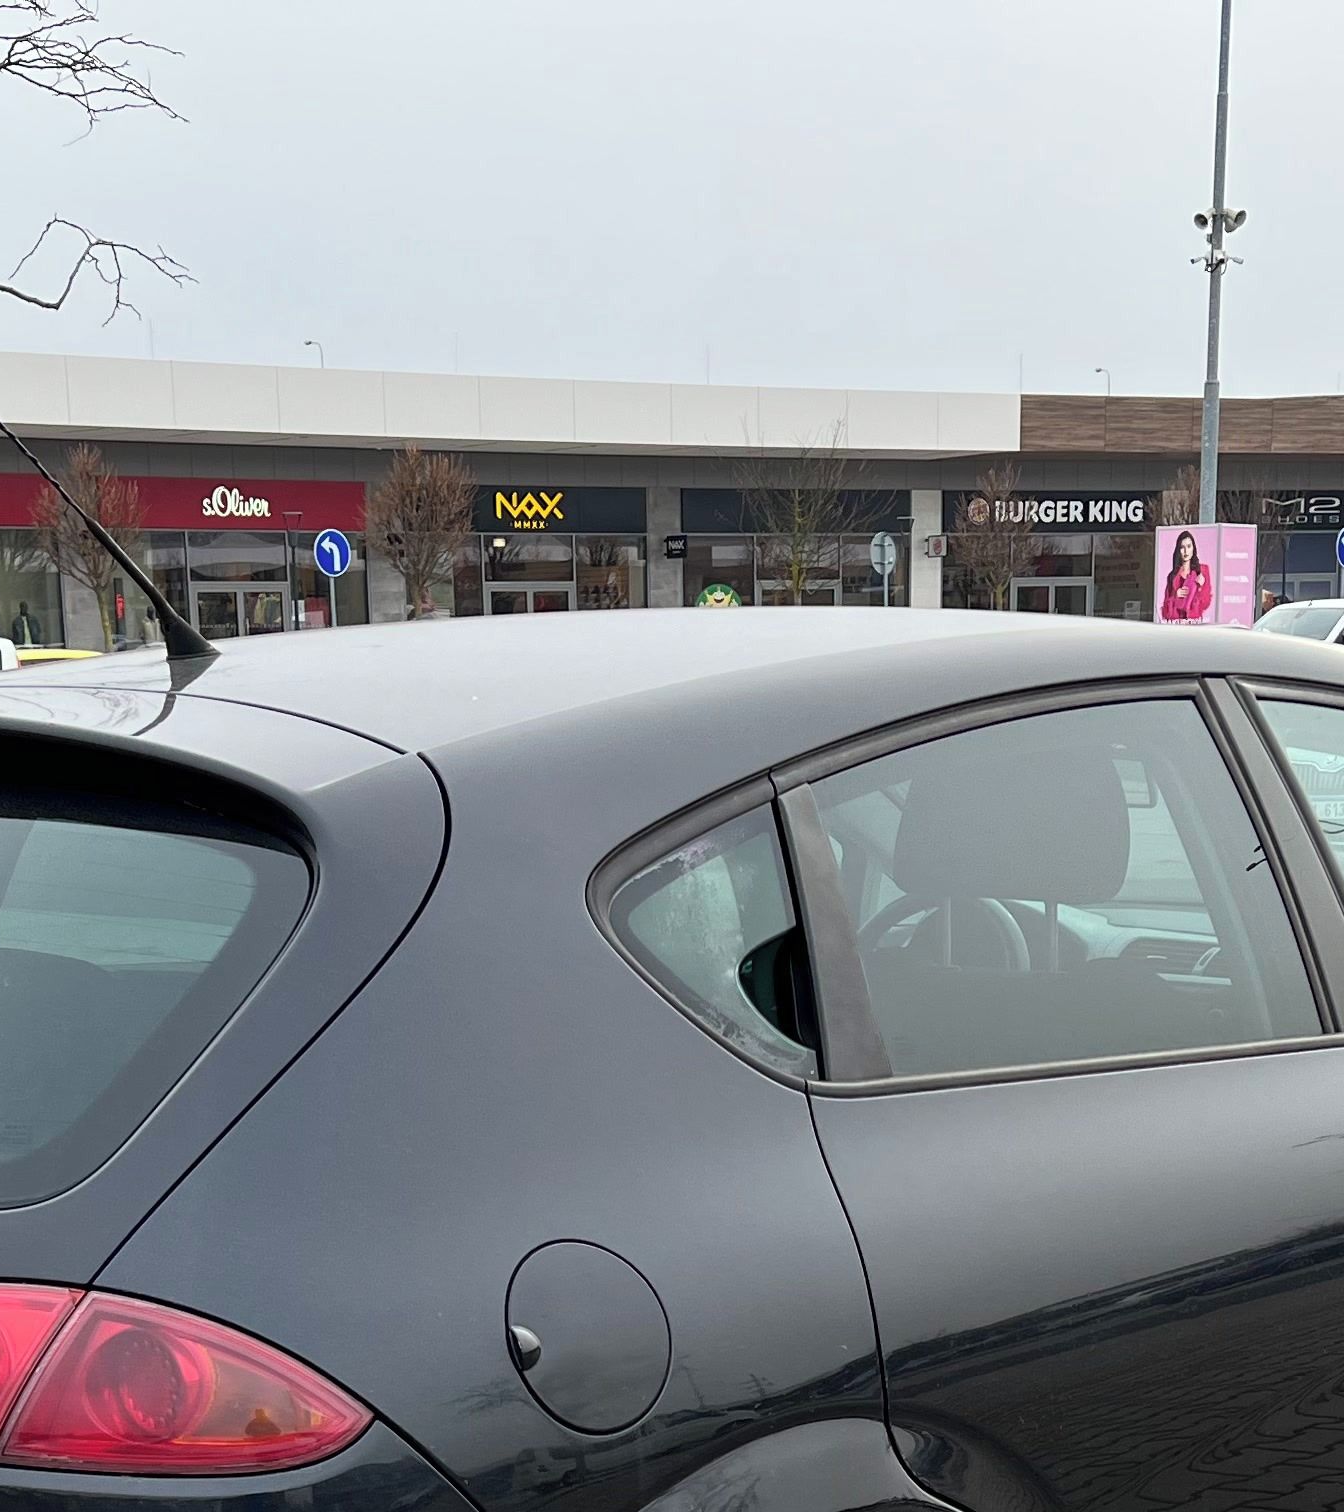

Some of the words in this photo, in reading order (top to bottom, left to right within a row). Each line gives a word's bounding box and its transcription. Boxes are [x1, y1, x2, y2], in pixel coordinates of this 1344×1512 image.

[202, 486, 272, 517] s.Oliver
[496, 491, 565, 520] NAX
[994, 500, 1084, 523] BURGER
[1088, 500, 1144, 523] KING
[1262, 496, 1341, 514] M2
